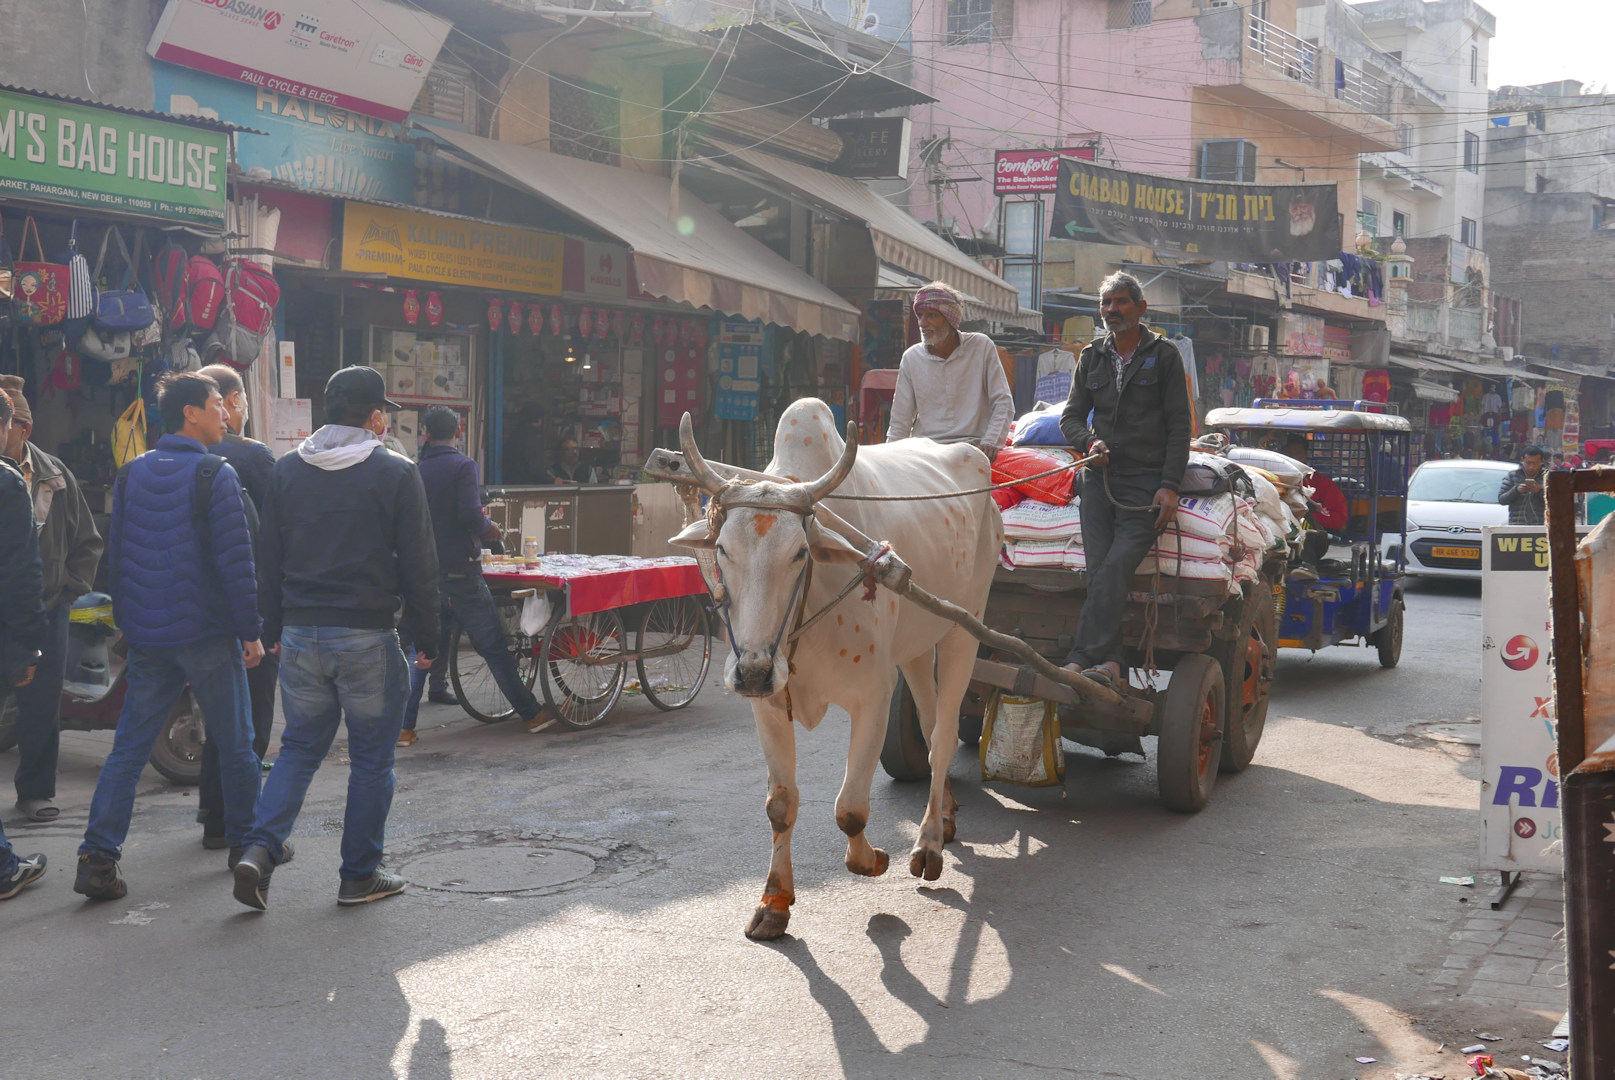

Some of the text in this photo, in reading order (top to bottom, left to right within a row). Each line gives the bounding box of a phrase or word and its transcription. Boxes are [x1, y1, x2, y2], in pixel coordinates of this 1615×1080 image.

[240, 70, 265, 86] PAUL
[267, 78, 299, 95] CYCLE
[308, 88, 339, 105] ELECT.
[58, 118, 118, 175] BAG
[128, 131, 219, 192] HOUSE
[331, 136, 357, 153] Live
[996, 157, 1059, 176] Comfort
[0, 180, 29, 192] ARKET,
[30, 183, 80, 199] PAHARGANJ,
[82, 191, 99, 201] NEW
[101, 193, 123, 204] DELHI
[175, 205, 187, 214] +91
[1070, 172, 1185, 215] CHABAD HOUSE
[1243, 195, 1276, 221] בית
[407, 225, 556, 263] KALINGA PREMIUM
[408, 262, 424, 274] PAUL
[426, 265, 445, 277] CYCLE
[1498, 537, 1549, 552] WES
